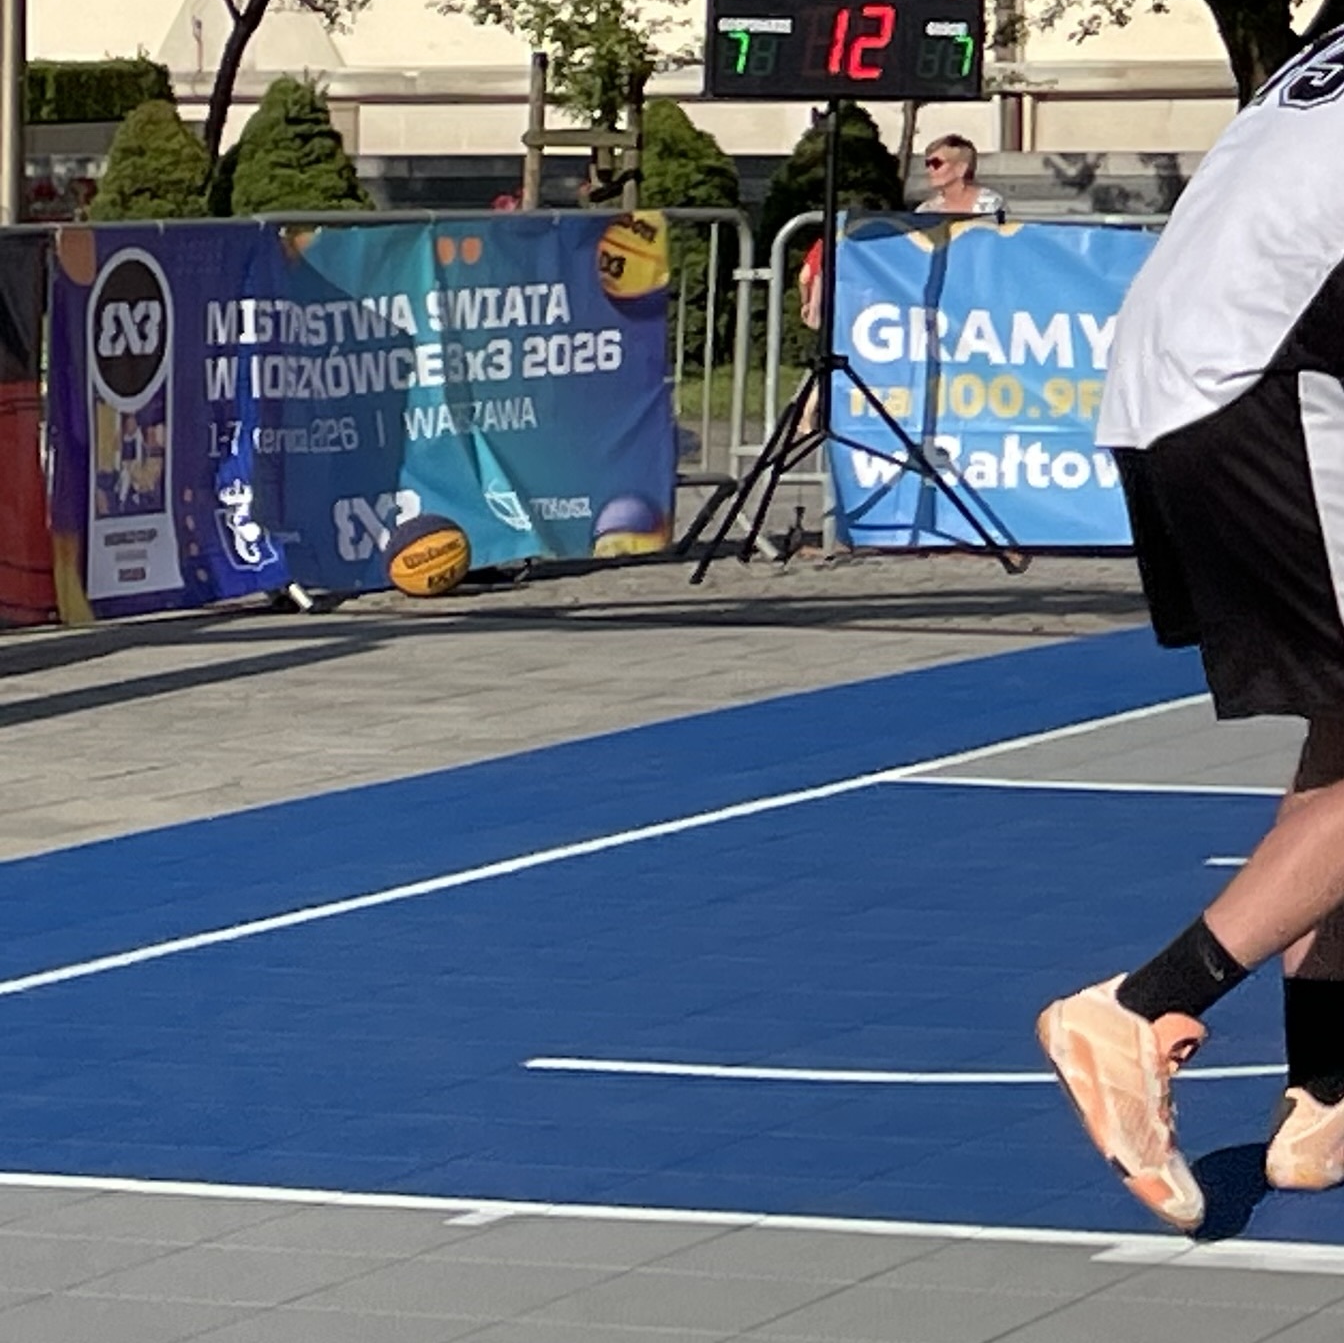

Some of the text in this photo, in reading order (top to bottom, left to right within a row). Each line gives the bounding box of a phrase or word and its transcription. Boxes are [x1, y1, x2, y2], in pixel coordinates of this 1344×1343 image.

[728, 29, 749, 75] 7
[827, 2, 896, 79] 12
[954, 35, 974, 77] 7
[852, 303, 1117, 369] GRAMY
[206, 356, 239, 401] W
[522, 329, 623, 379] 2026
[850, 386, 912, 418] na
